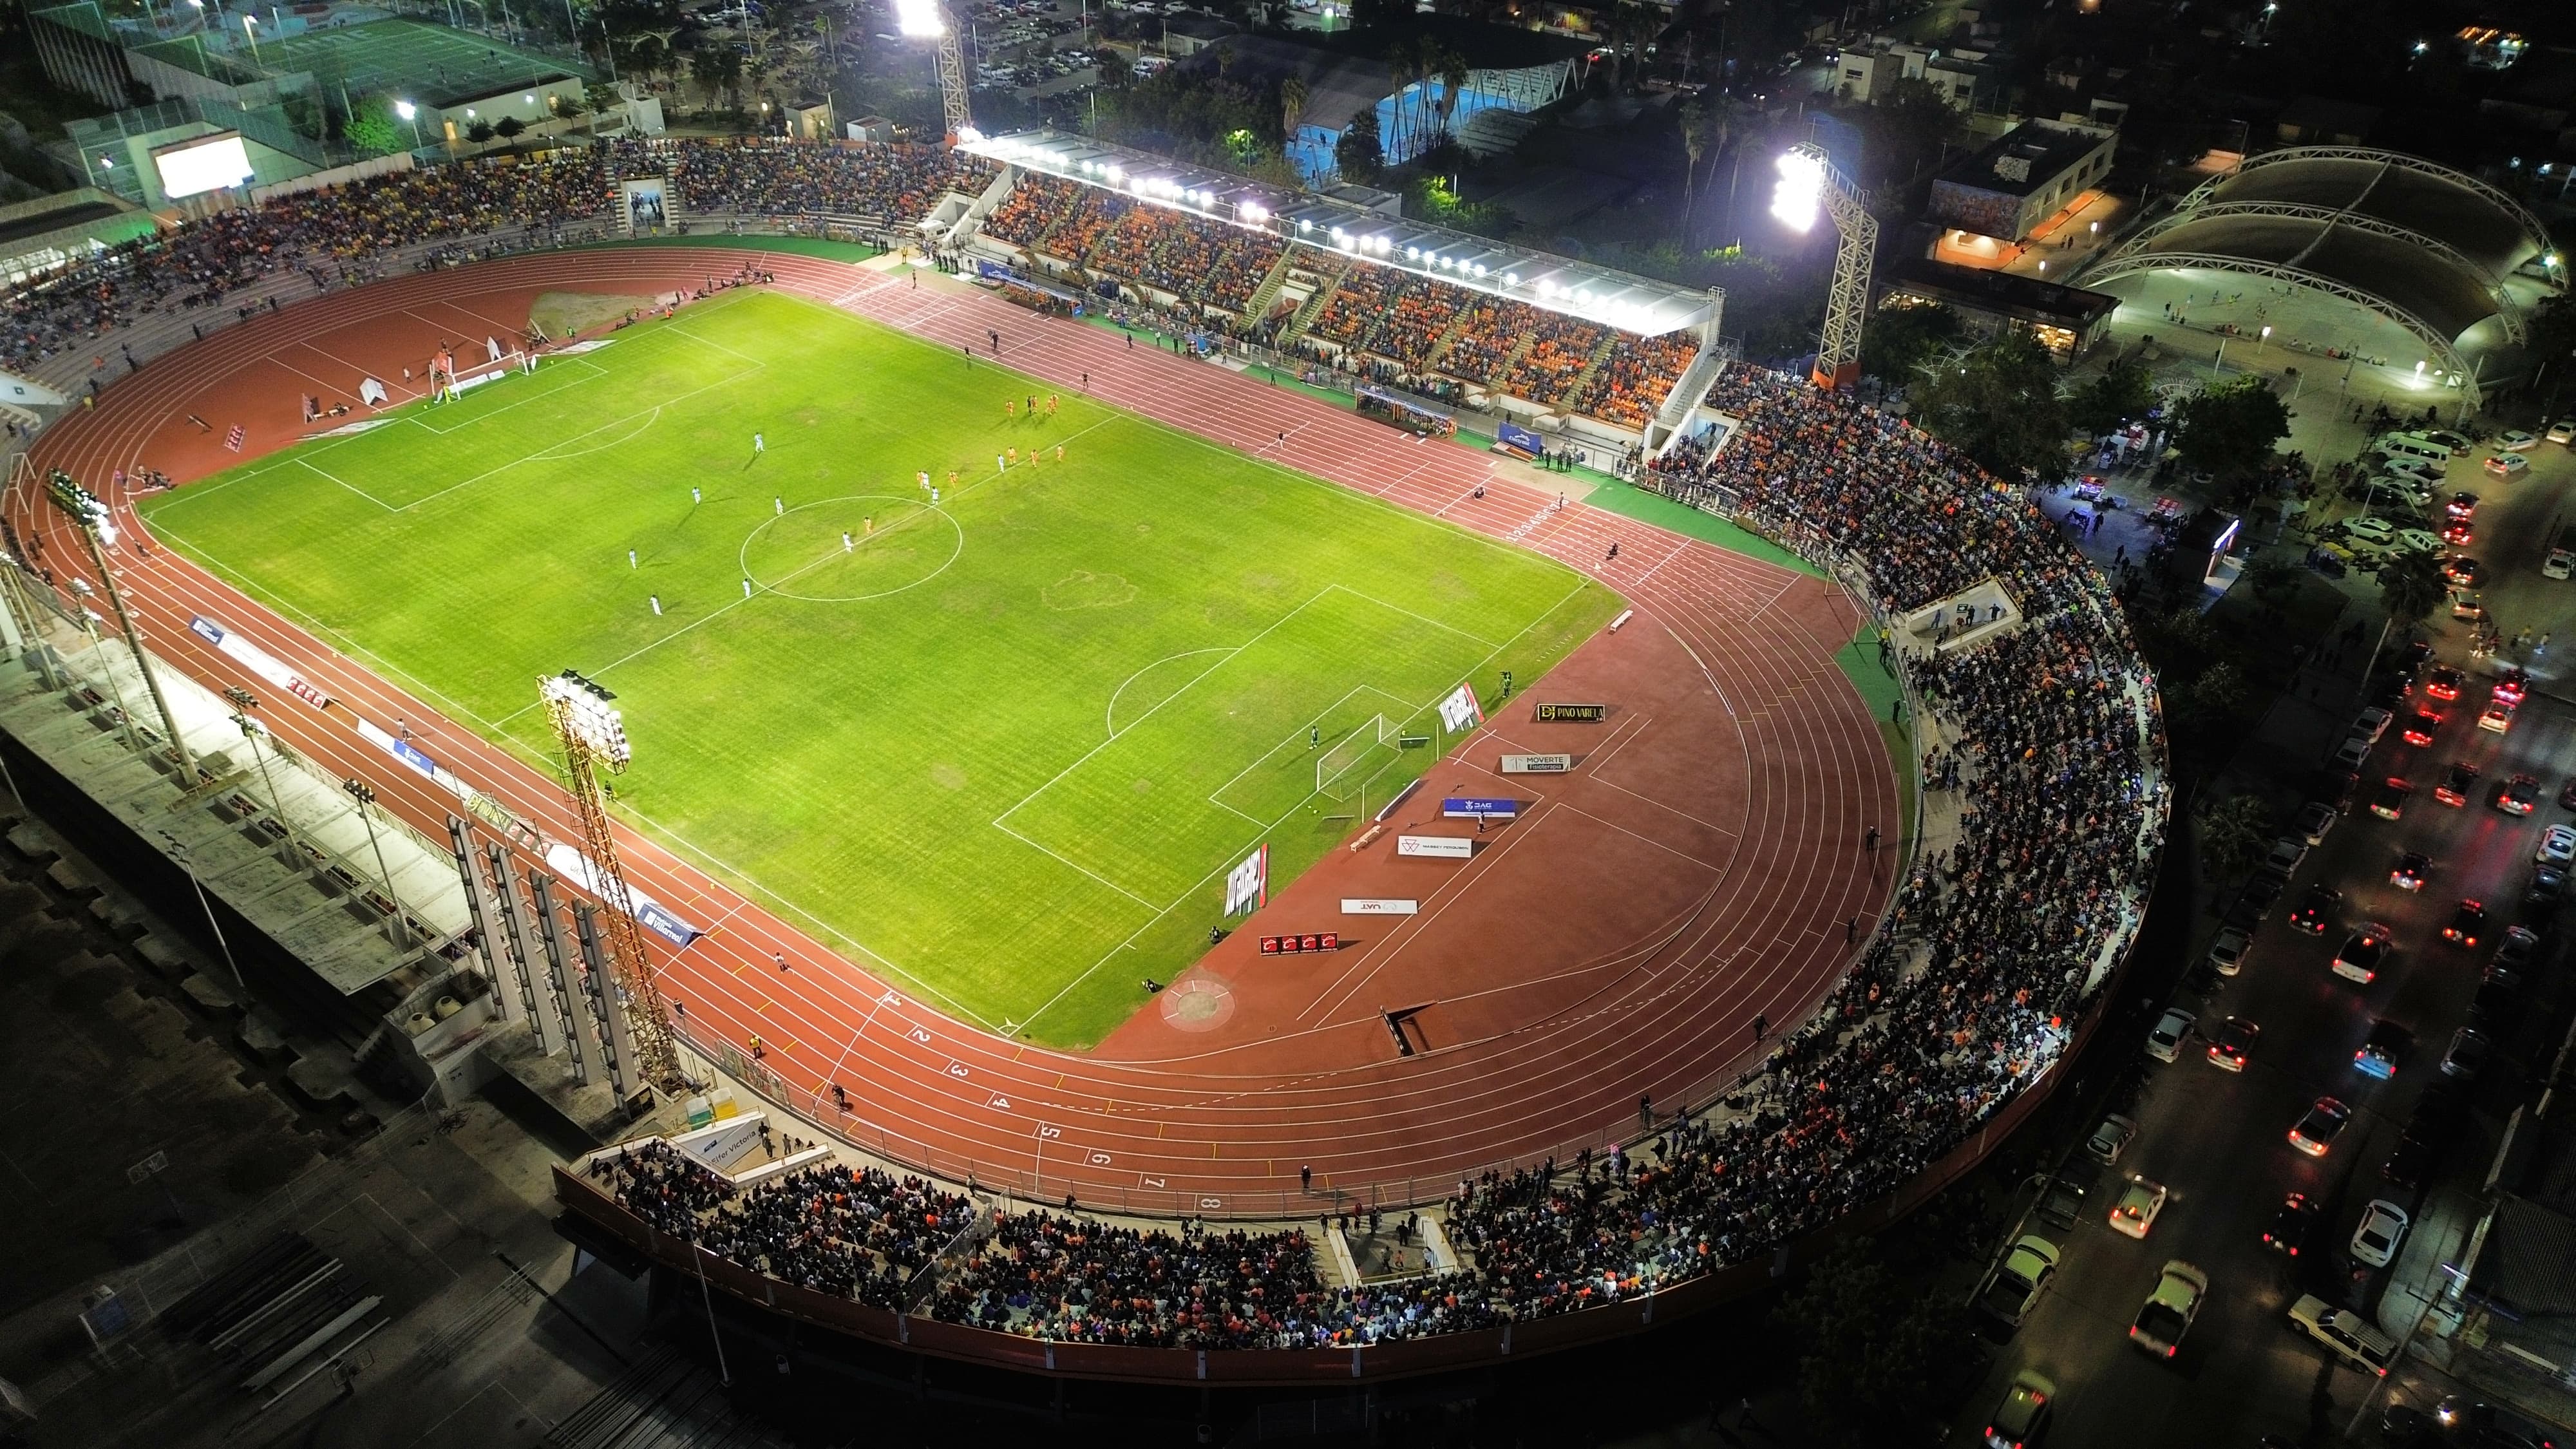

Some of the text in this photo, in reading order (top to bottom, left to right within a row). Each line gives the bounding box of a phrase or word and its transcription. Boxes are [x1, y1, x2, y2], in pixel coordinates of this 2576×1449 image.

[1540, 706, 1604, 720] DJ PINO VARELA
[654, 921, 683, 943] Villarreal
[912, 1029, 931, 1042] 2
[951, 1065, 969, 1076] 3
[992, 1097, 1011, 1109] 4
[1041, 1126, 1061, 1139] 5
[728, 1130, 756, 1152] Victoria
[1092, 1153, 1112, 1165] 6
[1144, 1177, 1166, 1189] 7
[1200, 1198, 1222, 1209] 8
